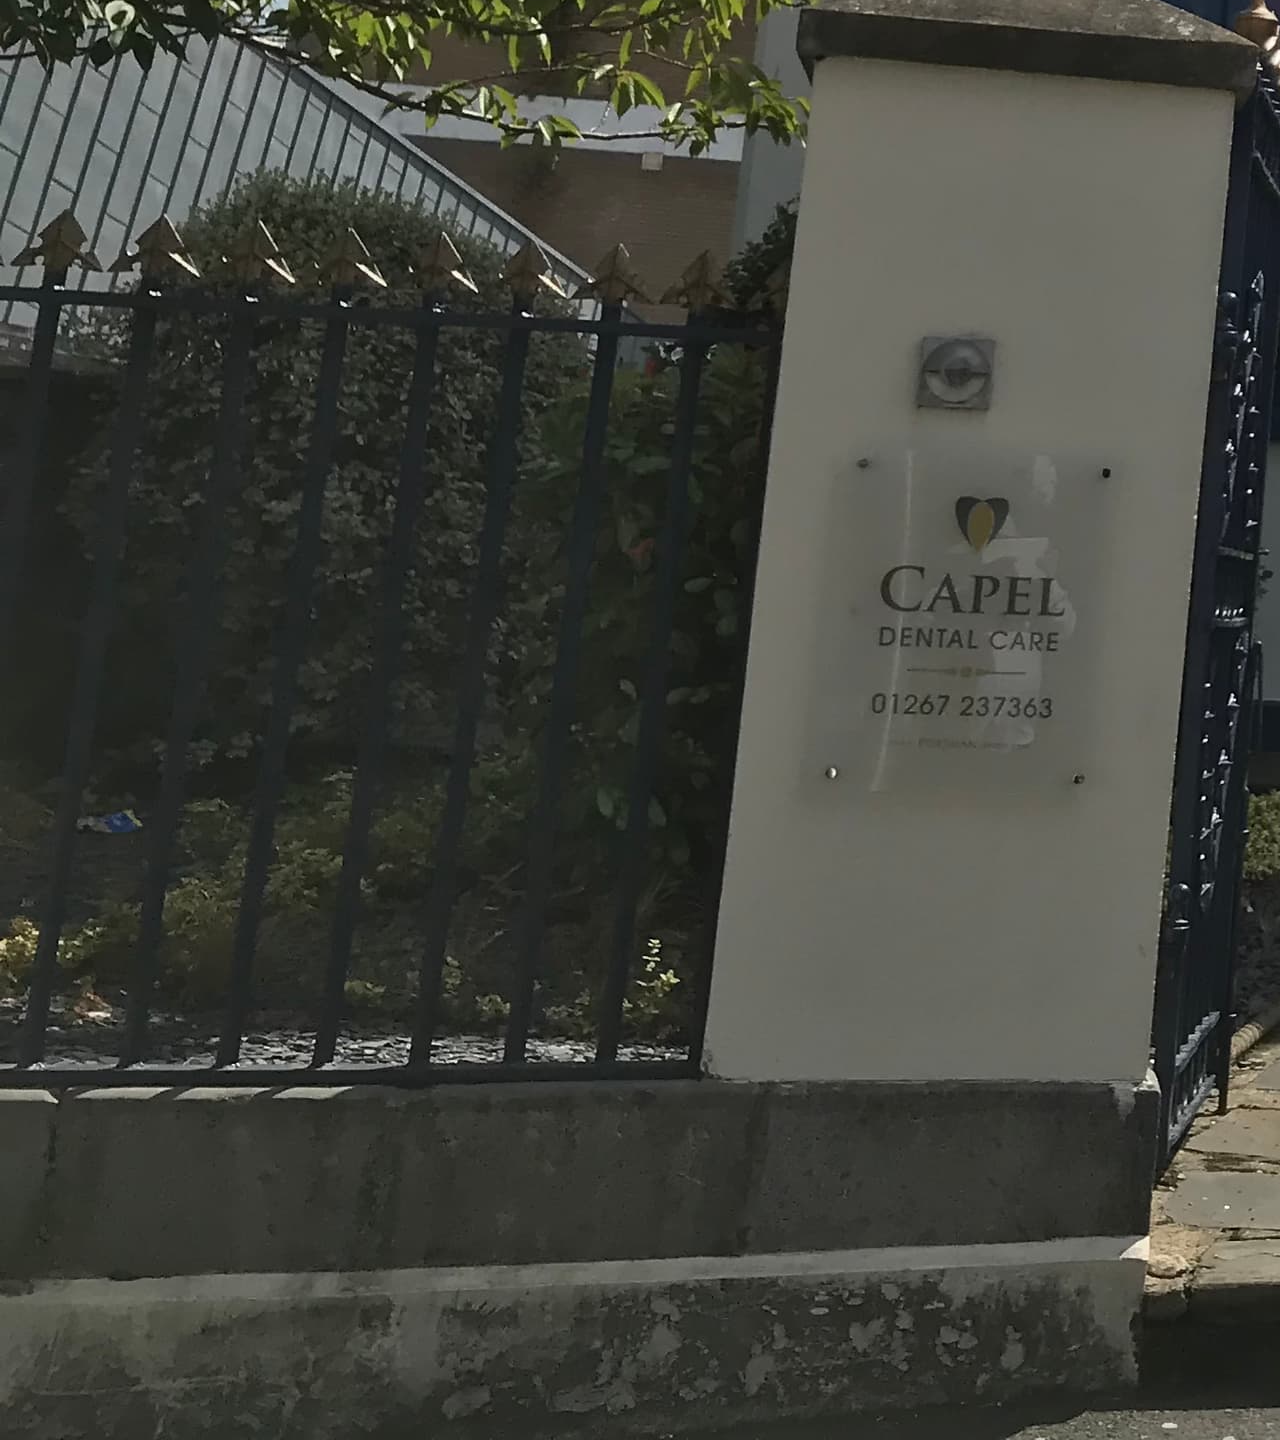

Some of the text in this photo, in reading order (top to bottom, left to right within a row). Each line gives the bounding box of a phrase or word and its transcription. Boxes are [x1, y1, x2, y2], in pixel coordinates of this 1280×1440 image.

[880, 564, 1066, 617] CAPEL
[878, 626, 1060, 651] DENTAL CARE
[871, 692, 1053, 719] 01267 237363
